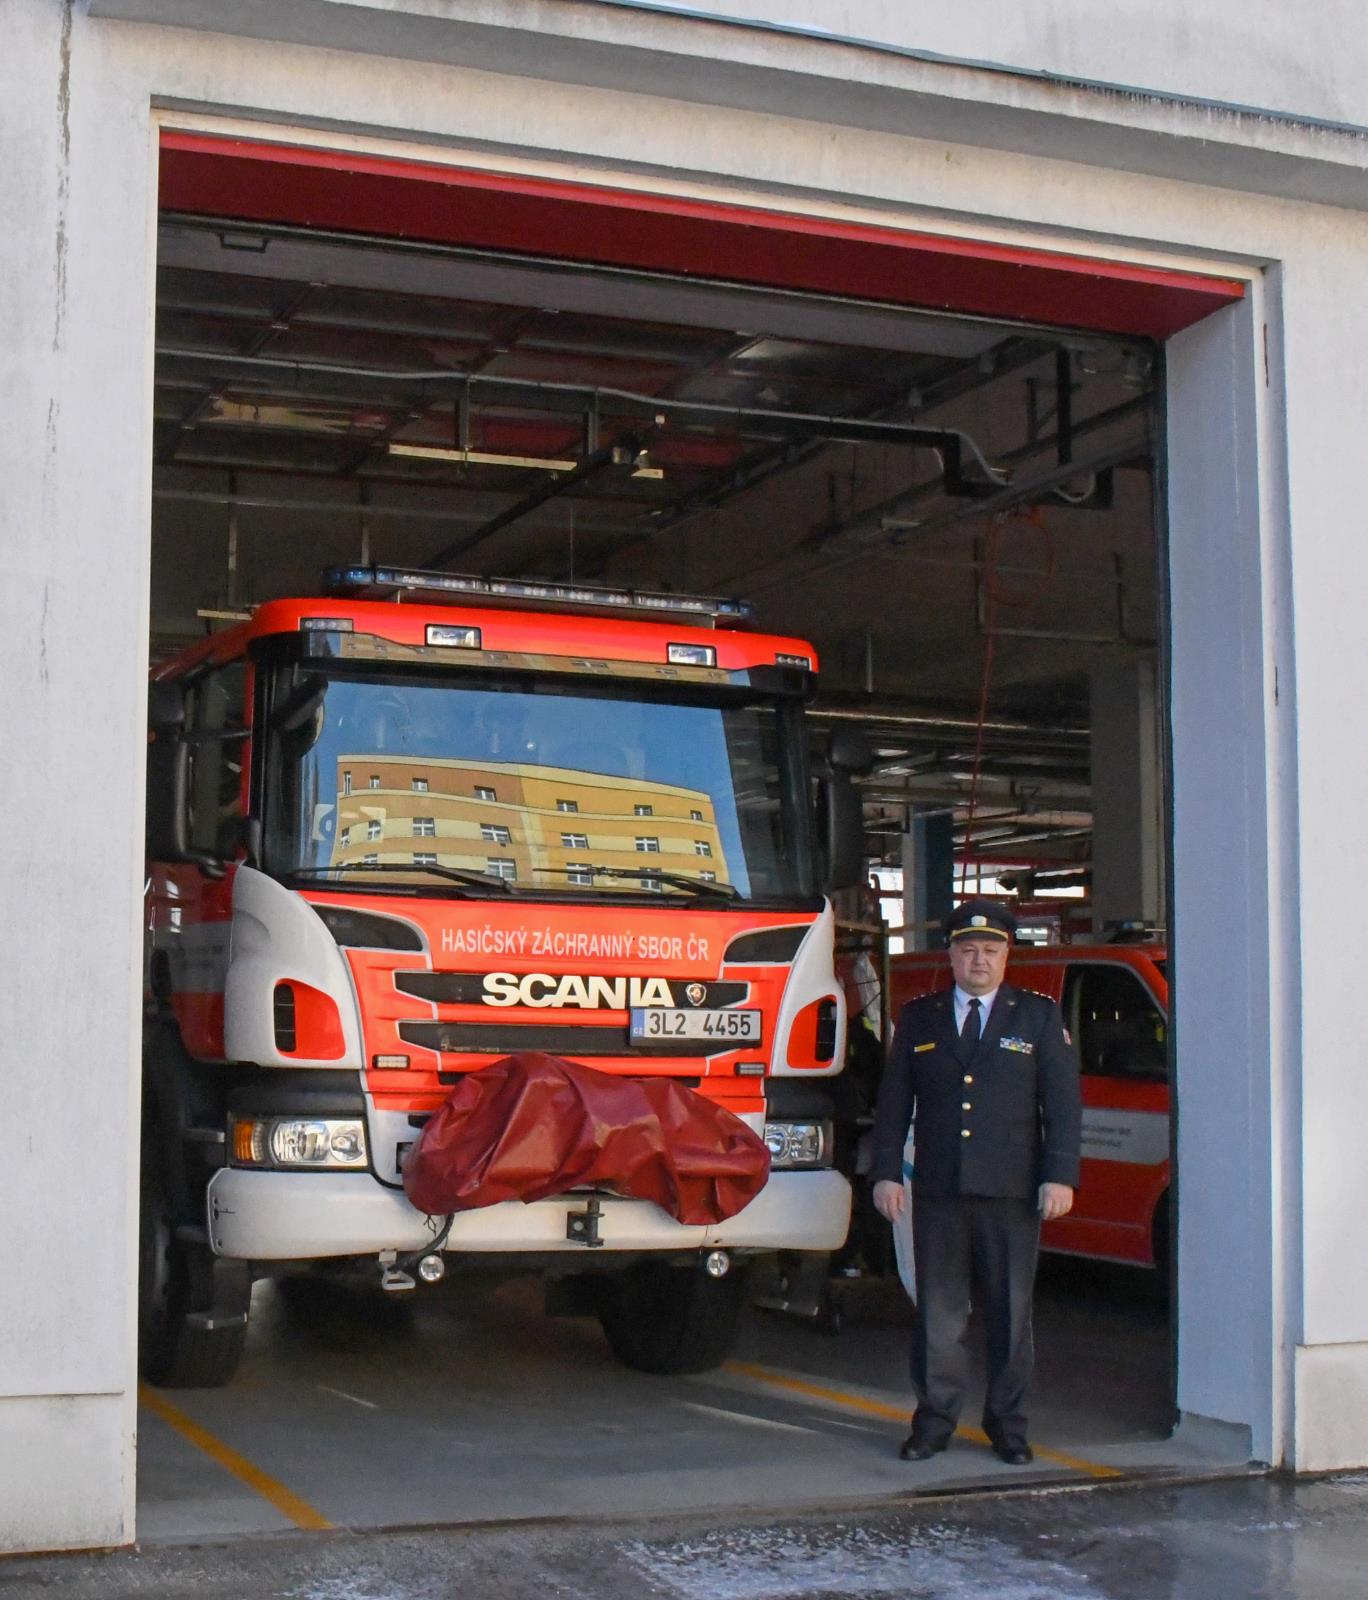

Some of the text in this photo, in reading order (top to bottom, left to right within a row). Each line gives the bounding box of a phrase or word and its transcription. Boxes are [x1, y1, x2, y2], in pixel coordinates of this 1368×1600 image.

[441, 924, 710, 961] HASIČSKÝ ZÁCHRANNÝ SBOR ČR
[481, 972, 675, 1010] SCANIA
[649, 1012, 752, 1036] 3L2 4455
